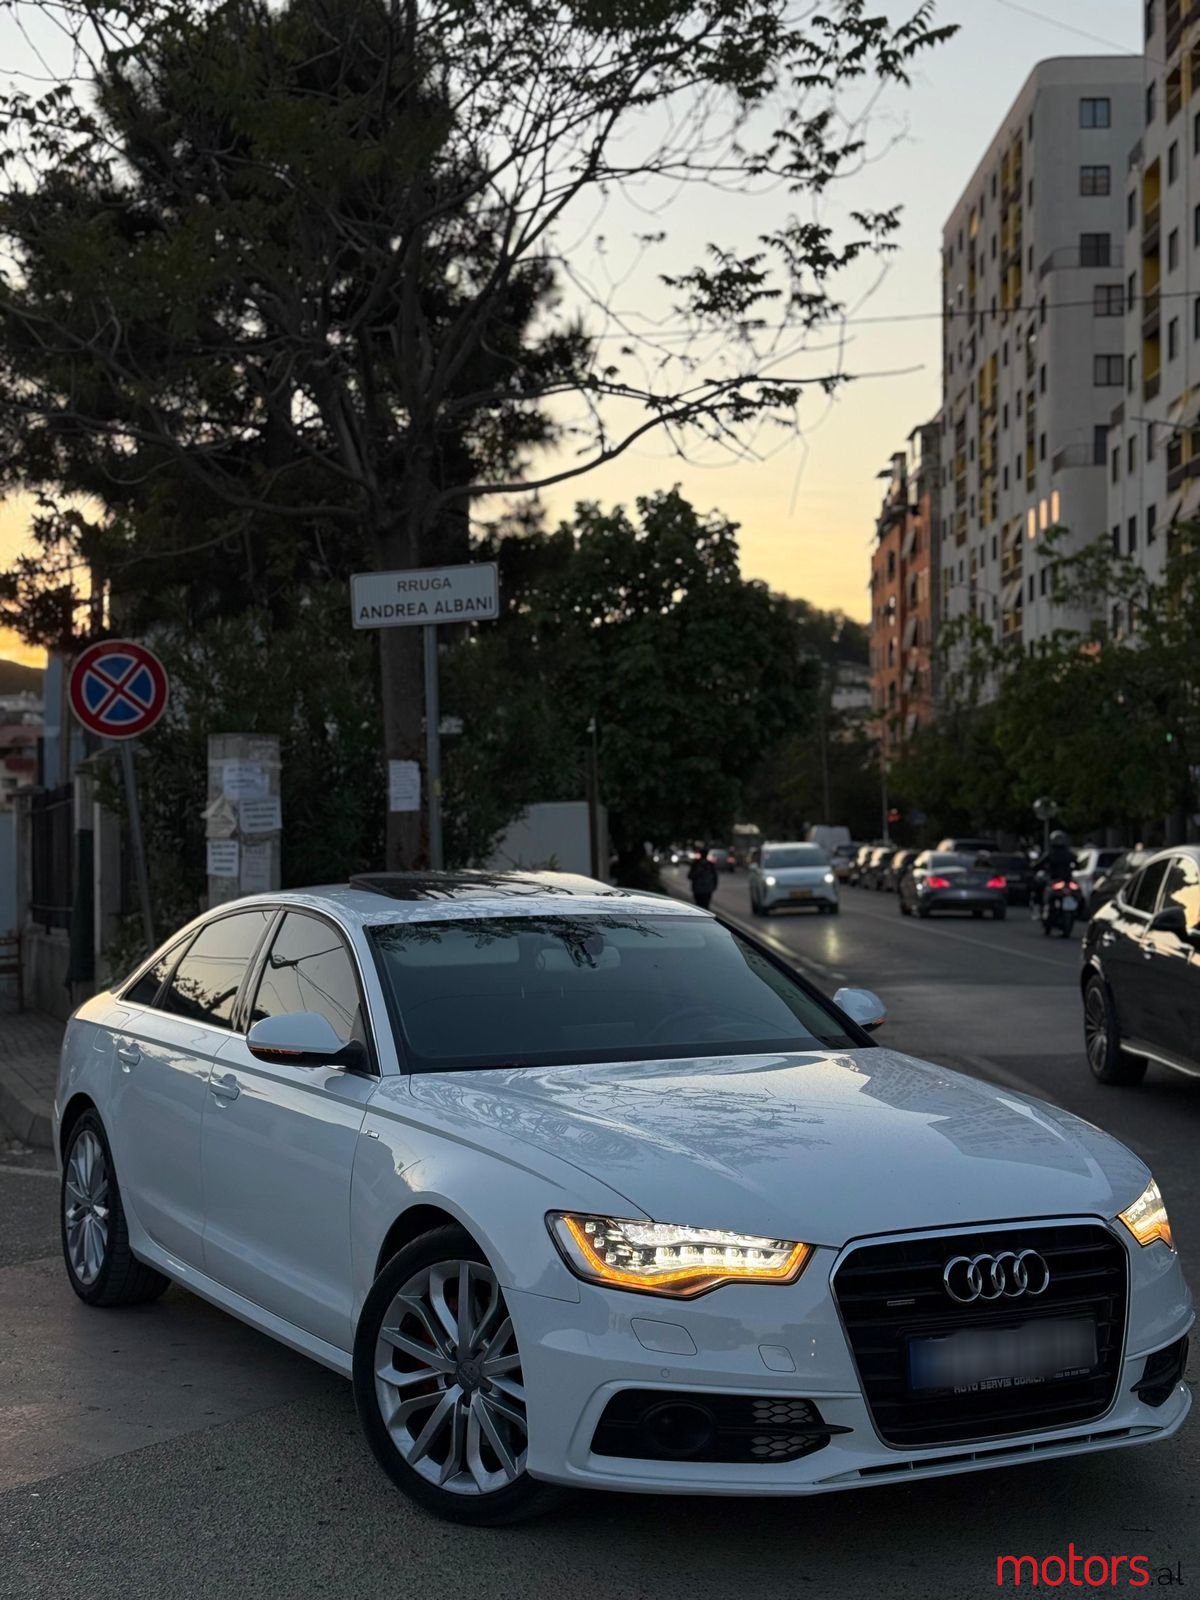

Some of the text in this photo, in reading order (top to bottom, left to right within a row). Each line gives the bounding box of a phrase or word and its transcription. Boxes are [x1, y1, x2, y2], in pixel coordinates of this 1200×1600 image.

[397, 577, 452, 592] RRUGA
[359, 596, 493, 619] ANDREA ALBANI
